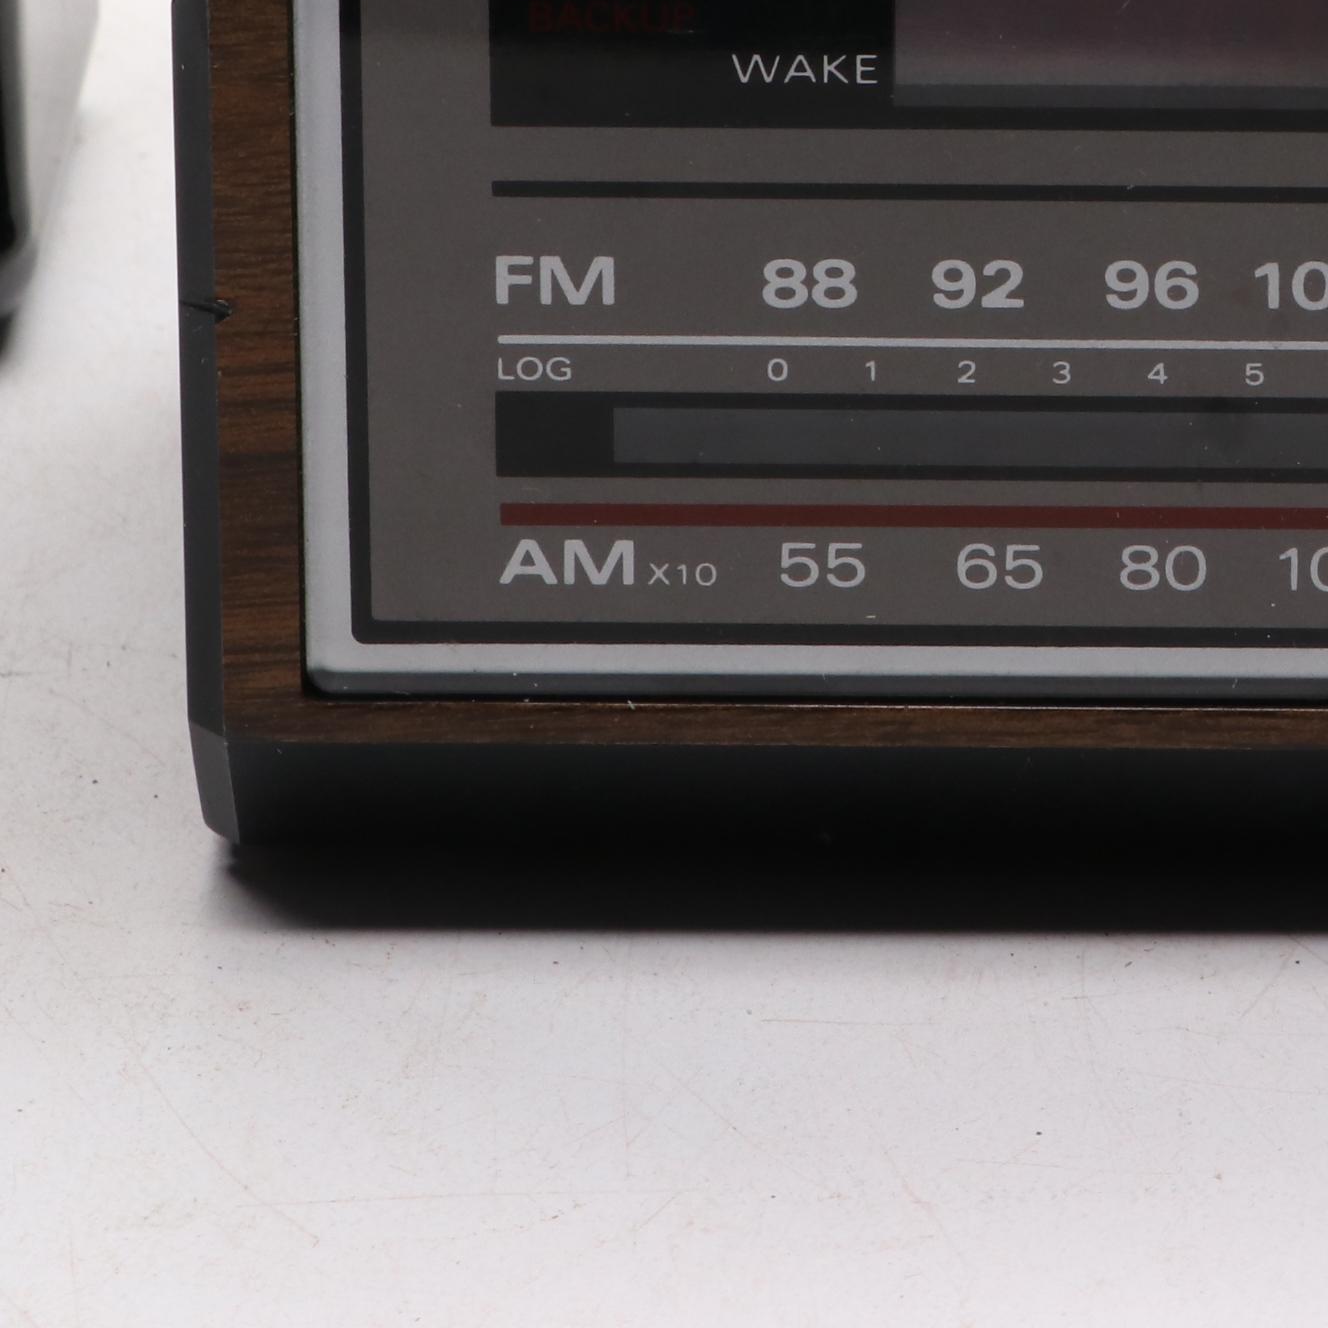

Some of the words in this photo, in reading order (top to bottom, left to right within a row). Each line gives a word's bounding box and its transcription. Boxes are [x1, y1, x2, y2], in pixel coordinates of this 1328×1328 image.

[528, 0, 698, 33] BACKUP
[731, 54, 879, 84] WAKE
[495, 255, 616, 306] FM
[762, 259, 858, 309] 88
[931, 260, 1025, 310] 92
[1104, 260, 1200, 310] 96
[497, 357, 573, 381] LOG
[767, 359, 789, 382] 0
[865, 361, 877, 382] 1
[957, 361, 977, 384] 2
[1052, 361, 1072, 385] 3
[1148, 362, 1169, 385] 4
[1245, 363, 1265, 386] 5
[500, 539, 635, 586] AM
[780, 543, 866, 587] 55
[956, 544, 1044, 589] 65
[1119, 546, 1207, 591] 80
